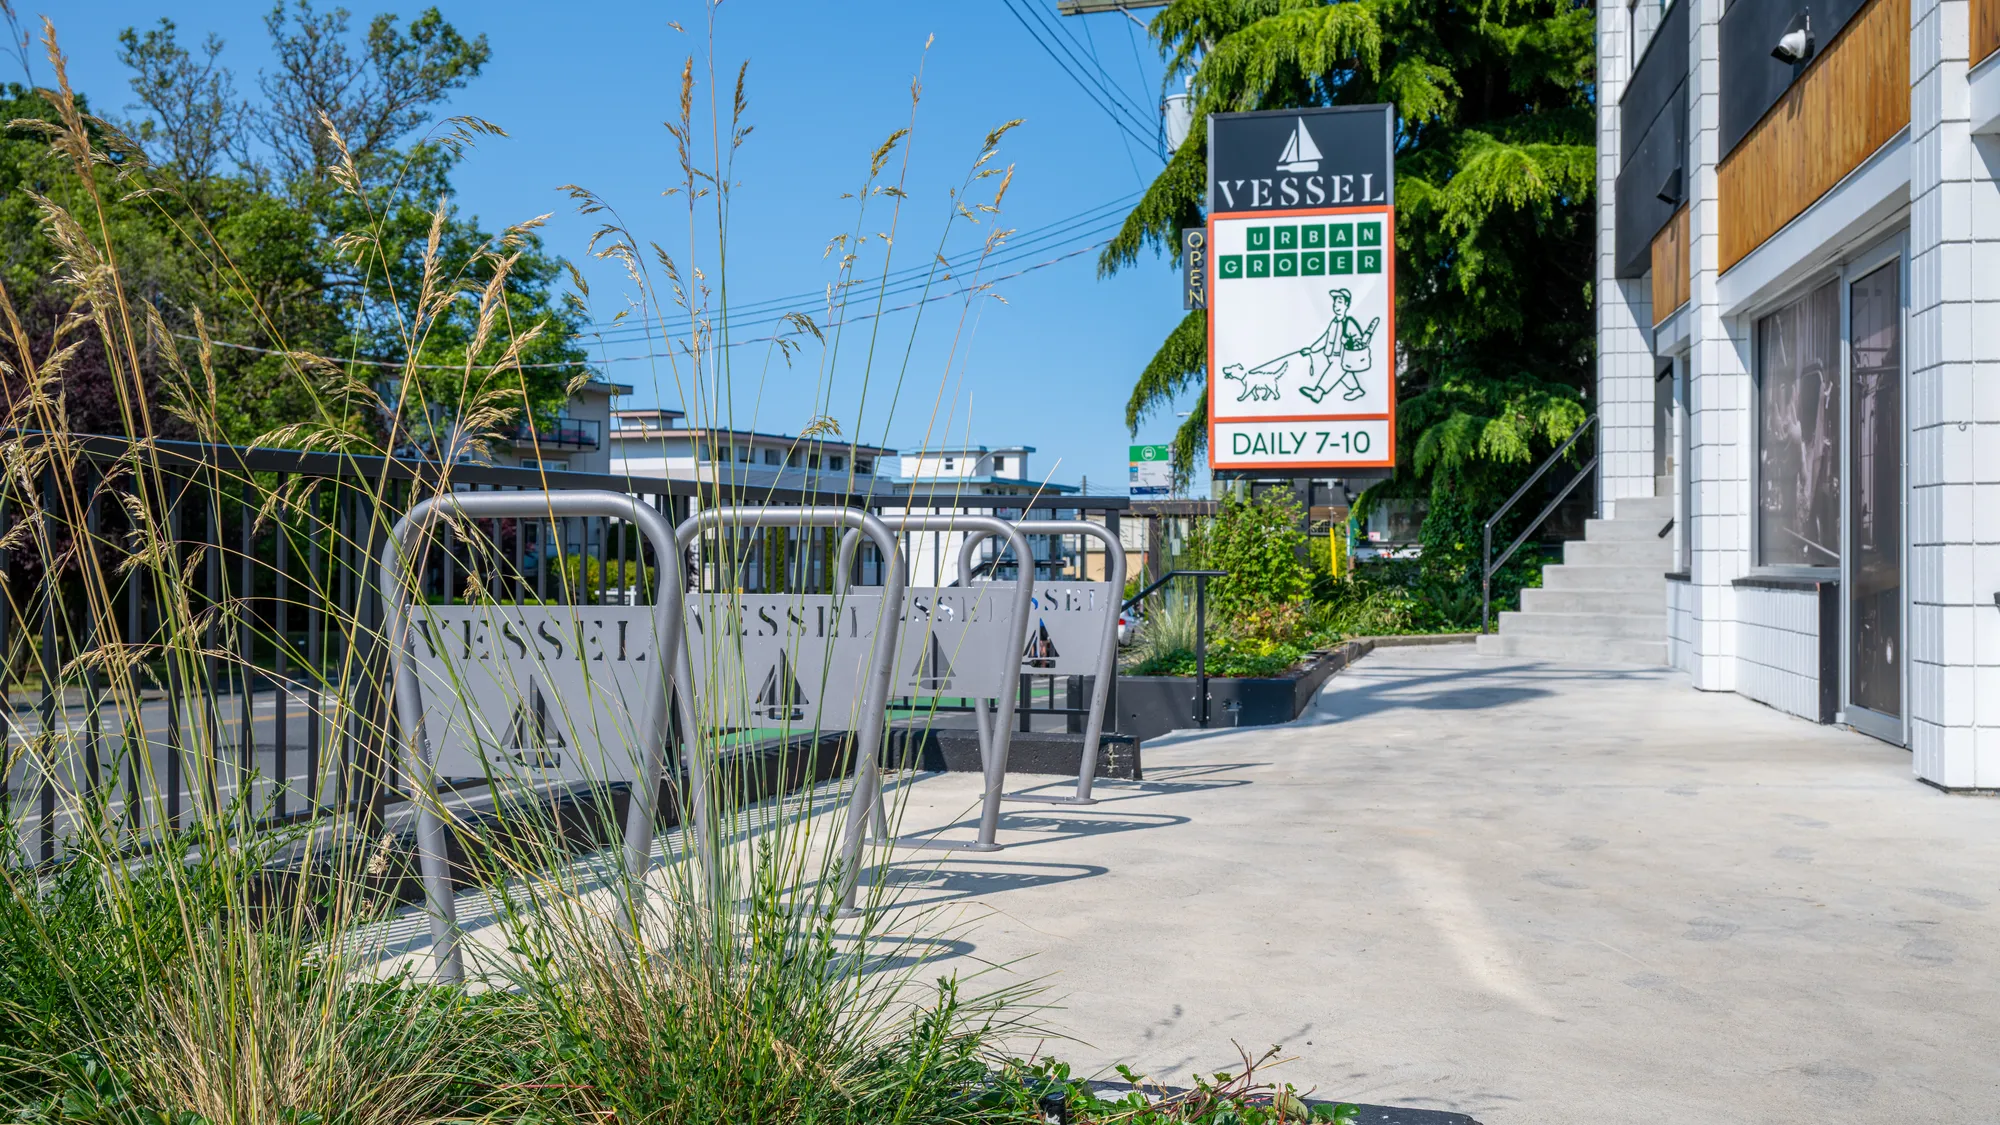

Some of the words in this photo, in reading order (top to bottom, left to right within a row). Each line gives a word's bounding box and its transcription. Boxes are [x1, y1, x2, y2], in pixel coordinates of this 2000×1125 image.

[1218, 173, 1384, 208] VESSEL
[1252, 228, 1374, 246] URBAN
[1187, 231, 1204, 305] OPEN
[1224, 255, 1375, 274] GROCER
[1233, 431, 1307, 455] DAILY
[1315, 431, 1371, 454] 7-10
[689, 604, 873, 638] VESSEL
[899, 596, 1008, 623] SSEL
[417, 619, 646, 662] VESSEL
